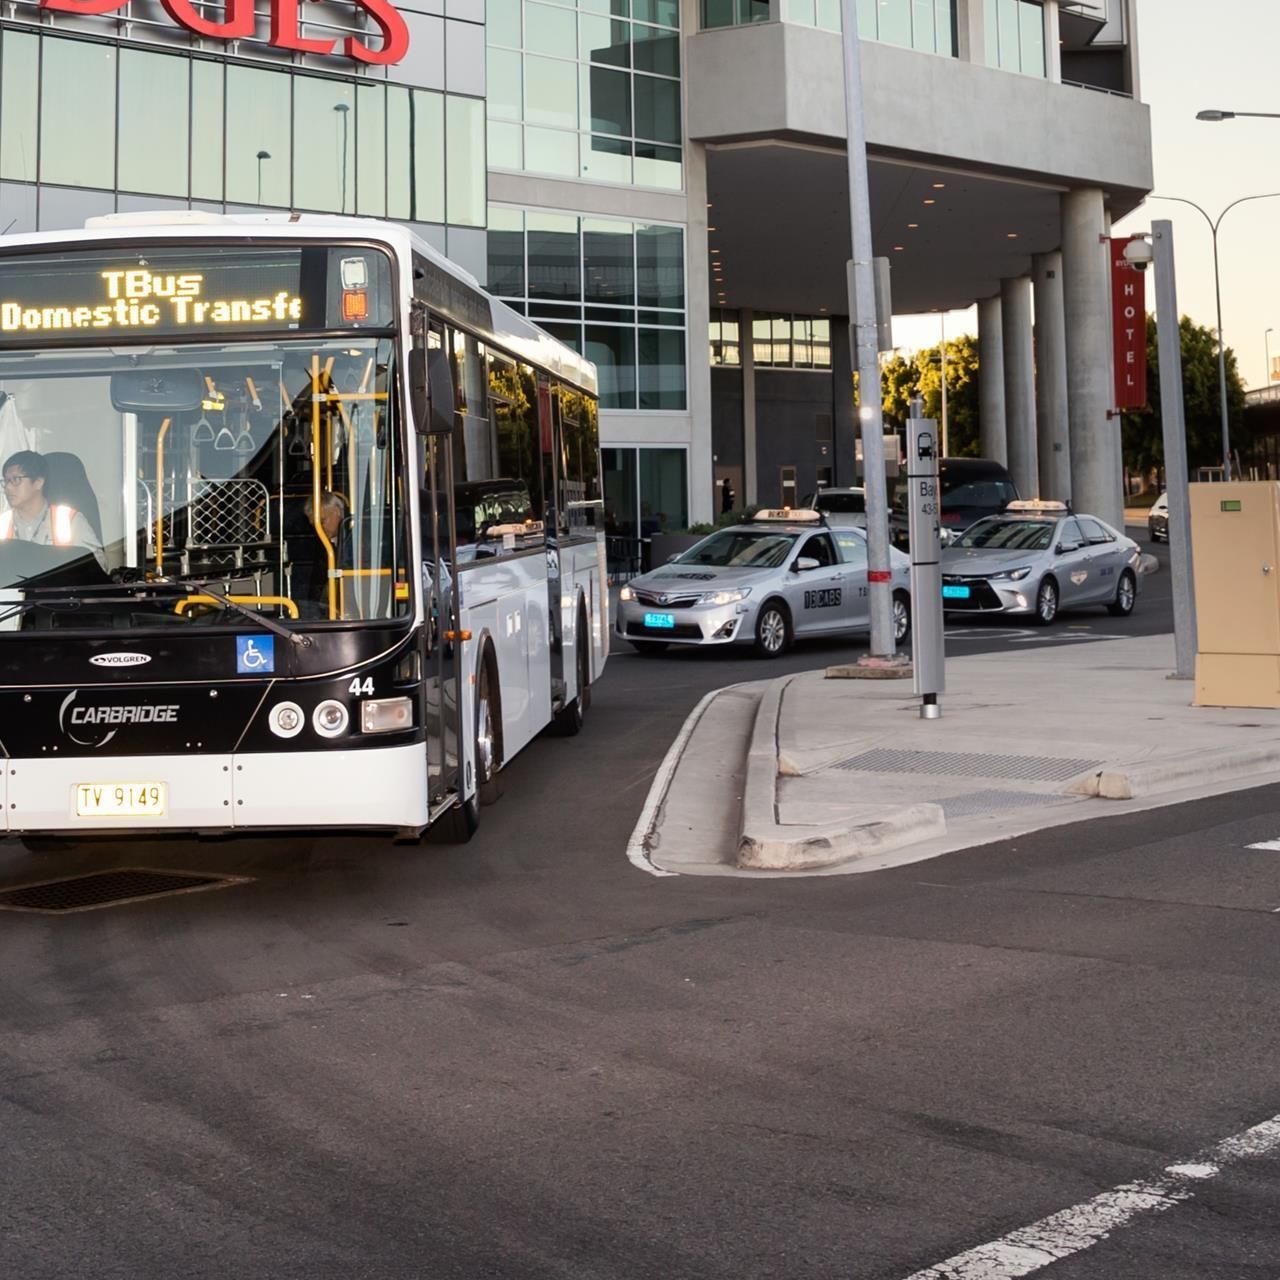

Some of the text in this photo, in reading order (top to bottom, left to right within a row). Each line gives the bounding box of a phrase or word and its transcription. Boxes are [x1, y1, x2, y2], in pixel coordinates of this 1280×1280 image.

[100, 269, 203, 299] TBus
[0, 296, 160, 331] Domestic
[1124, 283, 1135, 387] HOTEL
[107, 654, 148, 663] VOLGREN
[348, 676, 375, 696] 44
[70, 704, 180, 725] CARBRIDGE
[81, 787, 160, 807] TV 9149
